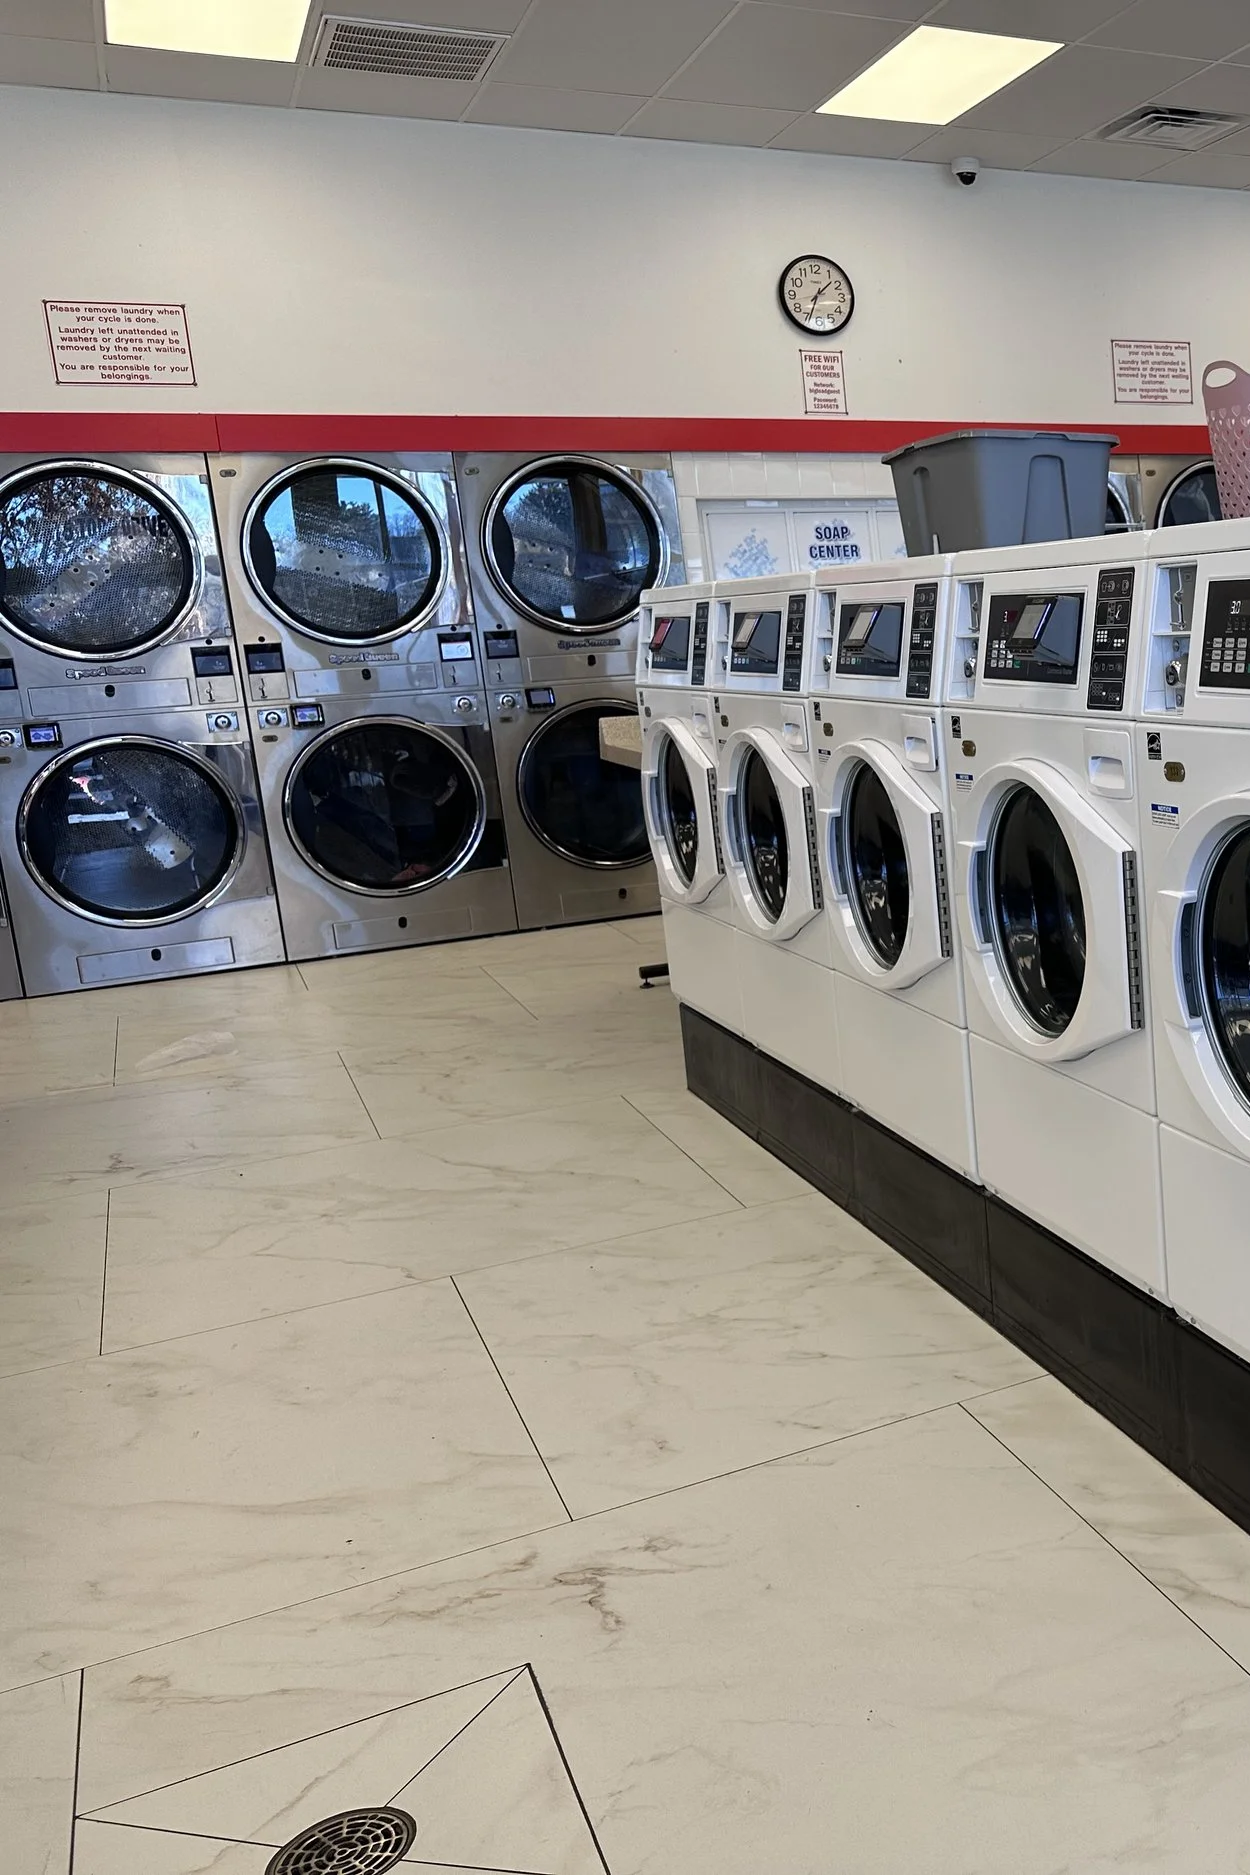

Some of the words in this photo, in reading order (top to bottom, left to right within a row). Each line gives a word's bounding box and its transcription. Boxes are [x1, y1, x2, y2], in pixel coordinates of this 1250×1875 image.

[799, 268, 806, 277] 11
[809, 264, 820, 274] 12
[827, 270, 830, 279] 1
[791, 278, 802, 287] 10
[834, 281, 842, 290] 2
[788, 290, 796, 299] 9
[838, 293, 845, 303] 3
[121, 307, 153, 315] laundry
[794, 303, 801, 312] 8
[835, 306, 842, 314] 4
[99, 315, 120, 323] cycle
[803, 312, 809, 321] 7
[816, 316, 823, 326] 6
[827, 314, 835, 323] 5
[155, 346, 186, 354] waiting
[101, 373, 152, 381] belongings.
[815, 526, 850, 541] SOAP
[809, 545, 860, 560] CENTER
